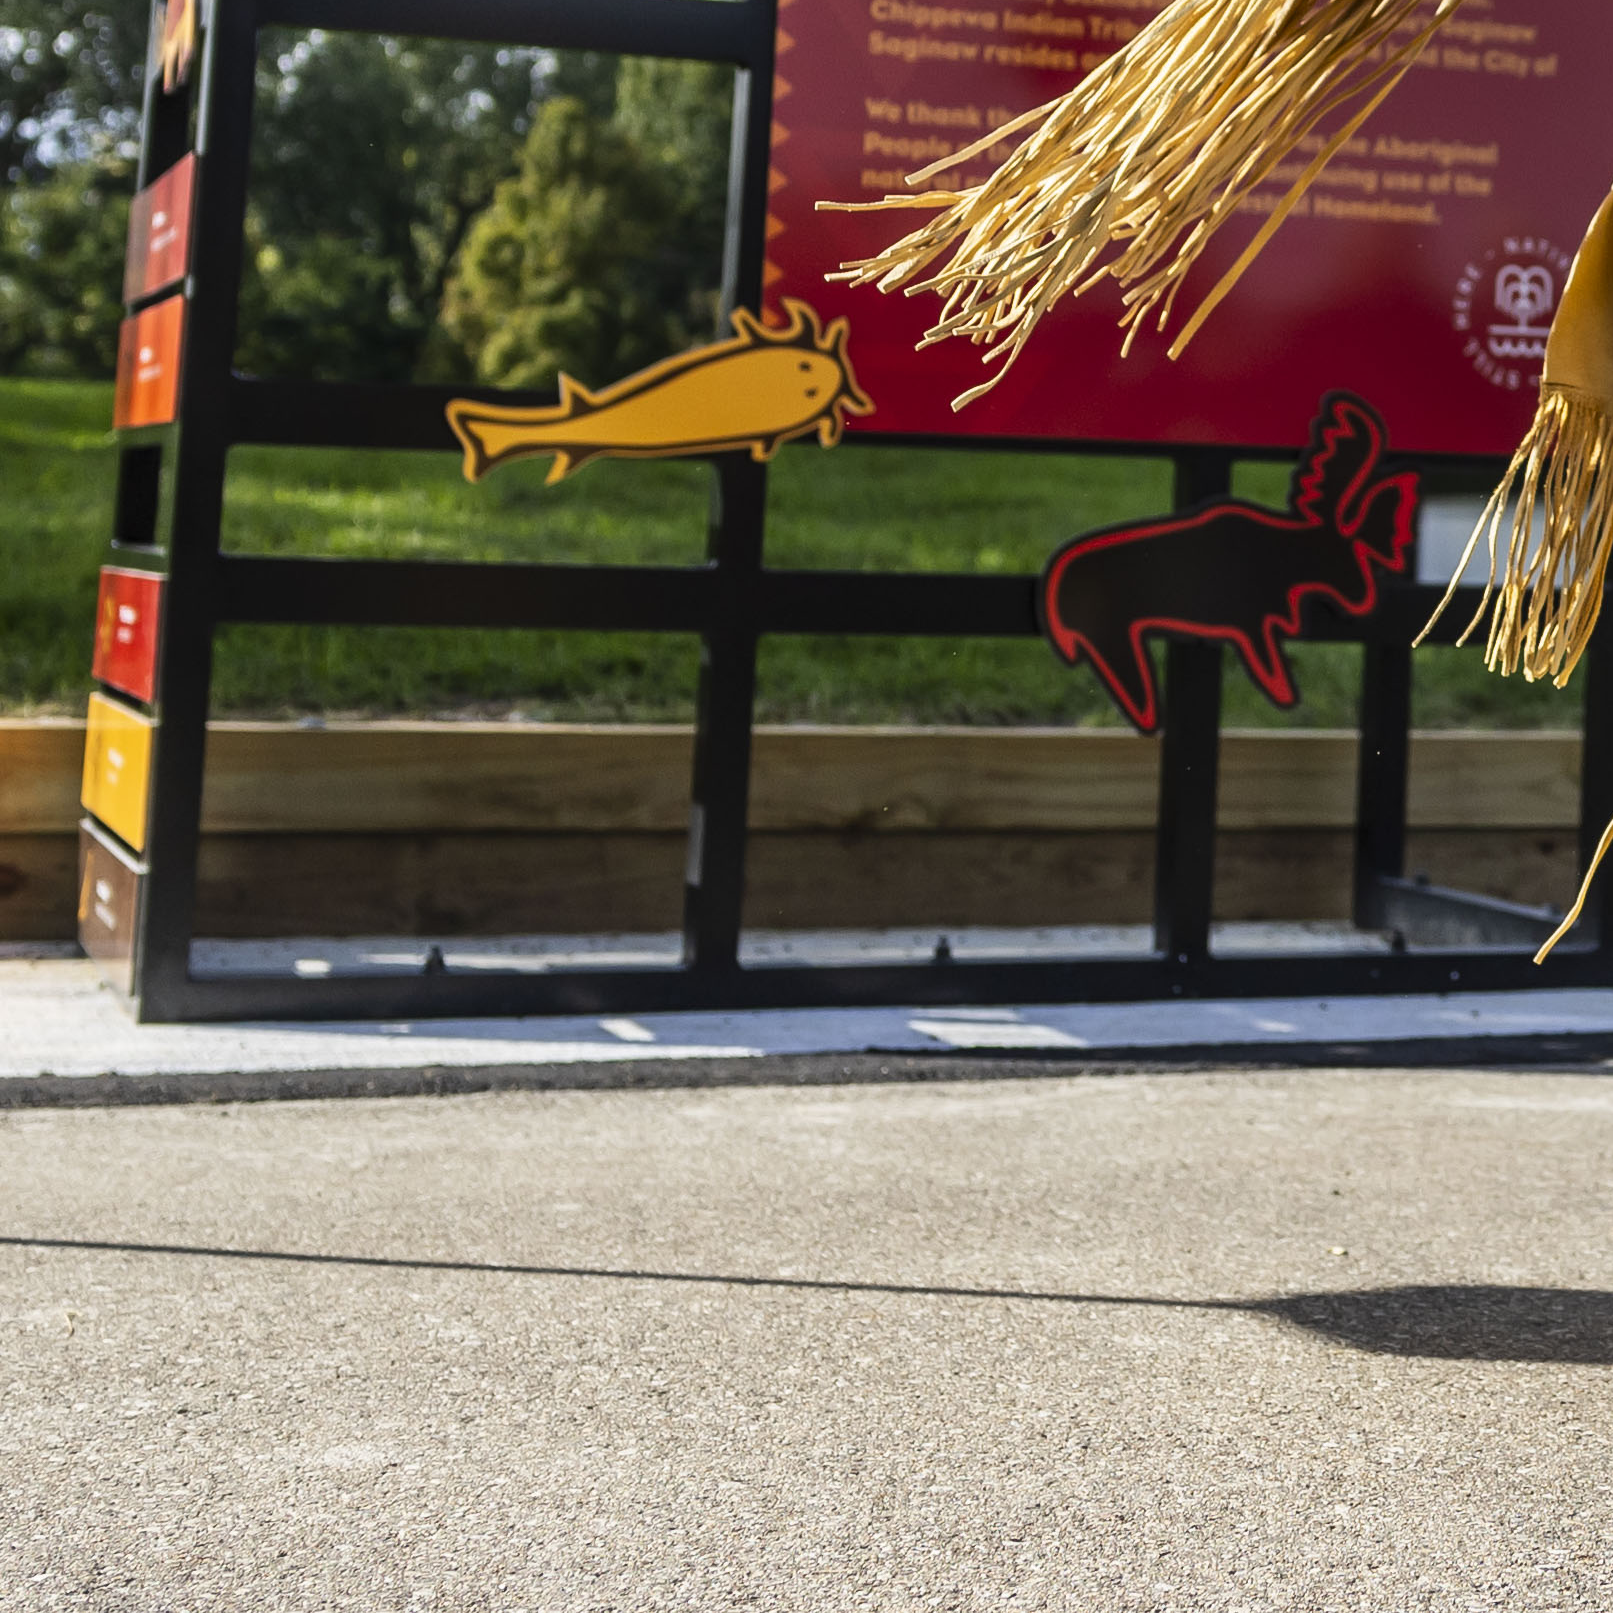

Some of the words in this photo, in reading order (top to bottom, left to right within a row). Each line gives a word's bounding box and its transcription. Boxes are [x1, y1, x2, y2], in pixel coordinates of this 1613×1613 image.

[869, 30, 978, 61] Saginaw
[982, 42, 1076, 70] resides
[1002, 7, 1084, 35] Indian
[1443, 46, 1480, 70] the
[1483, 49, 1531, 78] City
[1533, 52, 1558, 77] of
[865, 98, 902, 122] We
[906, 102, 981, 127] thank
[1373, 135, 1499, 166] Aboriginal
[1382, 172, 1424, 192] use
[1428, 169, 1452, 193] of
[1454, 172, 1492, 197] the
